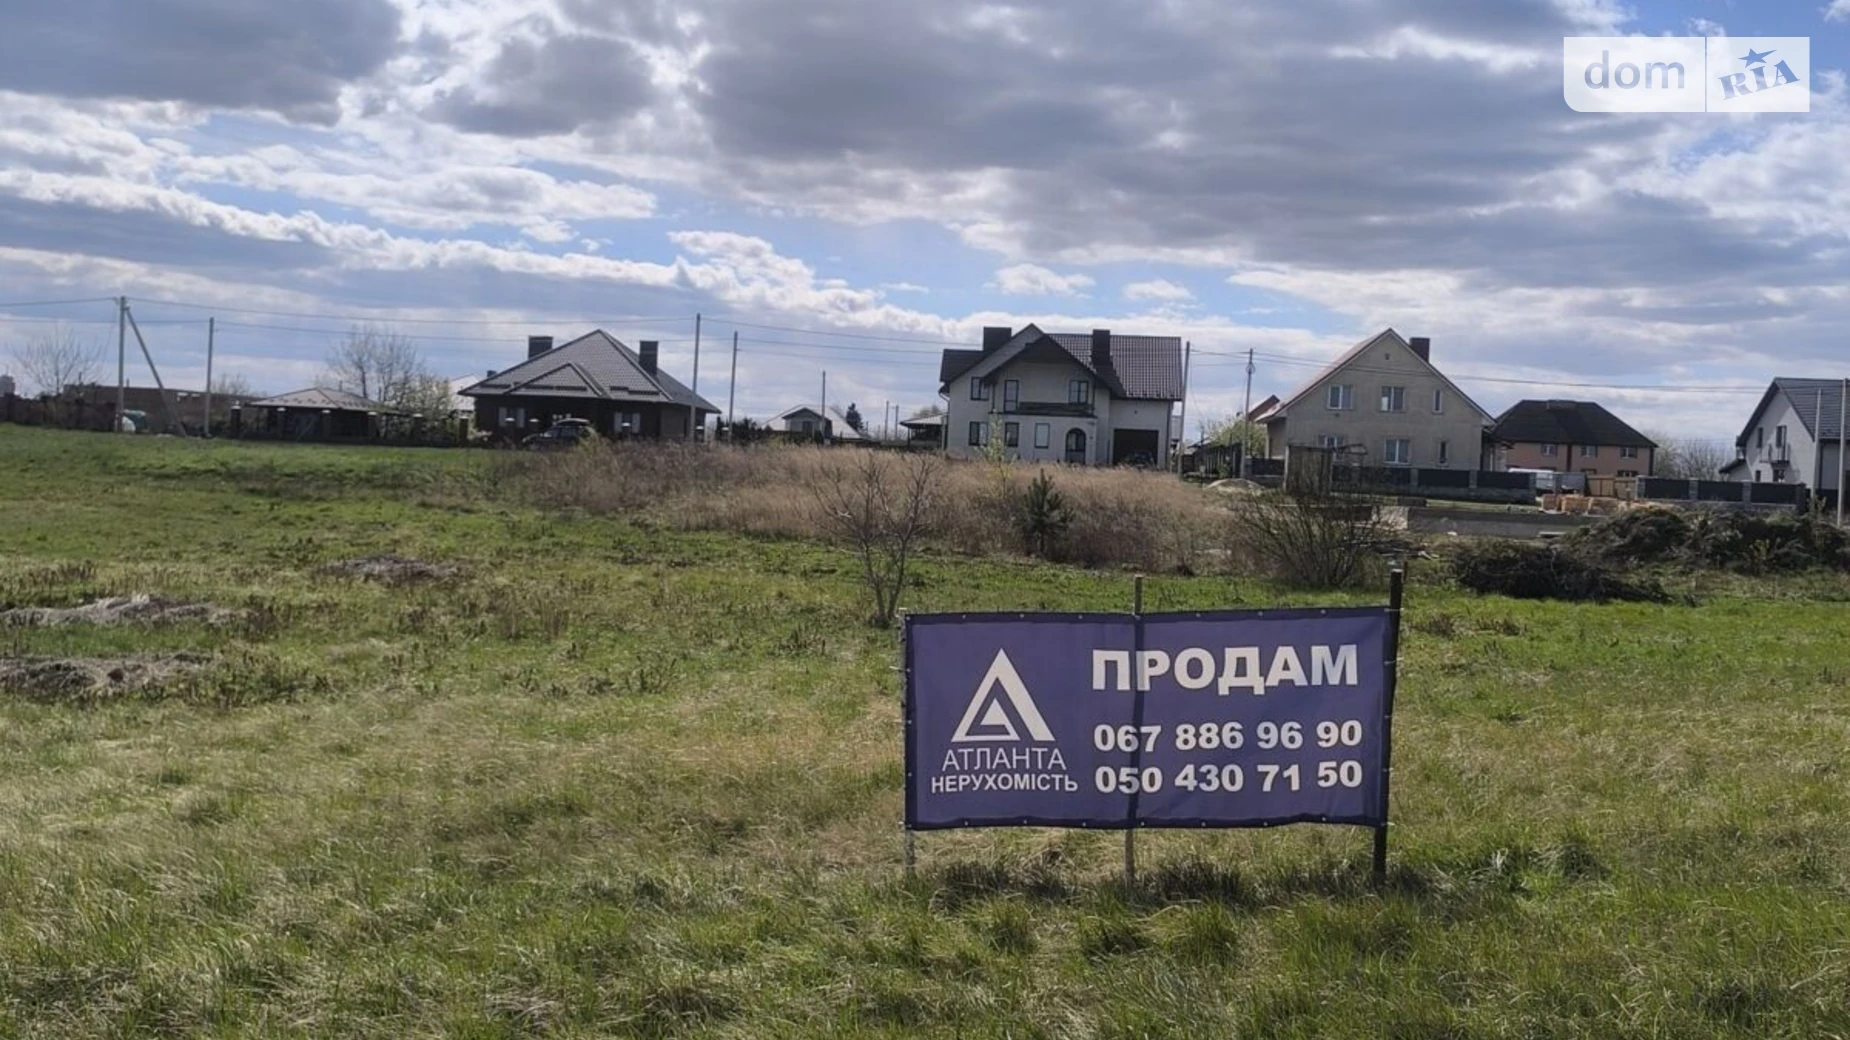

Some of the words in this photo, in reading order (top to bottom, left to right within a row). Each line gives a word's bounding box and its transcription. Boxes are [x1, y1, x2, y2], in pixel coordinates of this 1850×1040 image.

[1092, 644, 1358, 695] ПРОДАМ
[1094, 724, 1162, 752] 067
[1175, 722, 1244, 750] 886
[1256, 721, 1303, 749] 96
[1317, 719, 1363, 748] 90
[942, 747, 1067, 772] АТЛАНТА
[931, 773, 1078, 794] НЕРУХОМІСТЬ
[1095, 766, 1162, 793] 050
[1175, 764, 1244, 792] 430
[1257, 764, 1301, 792] 71
[1317, 760, 1363, 788] 50
